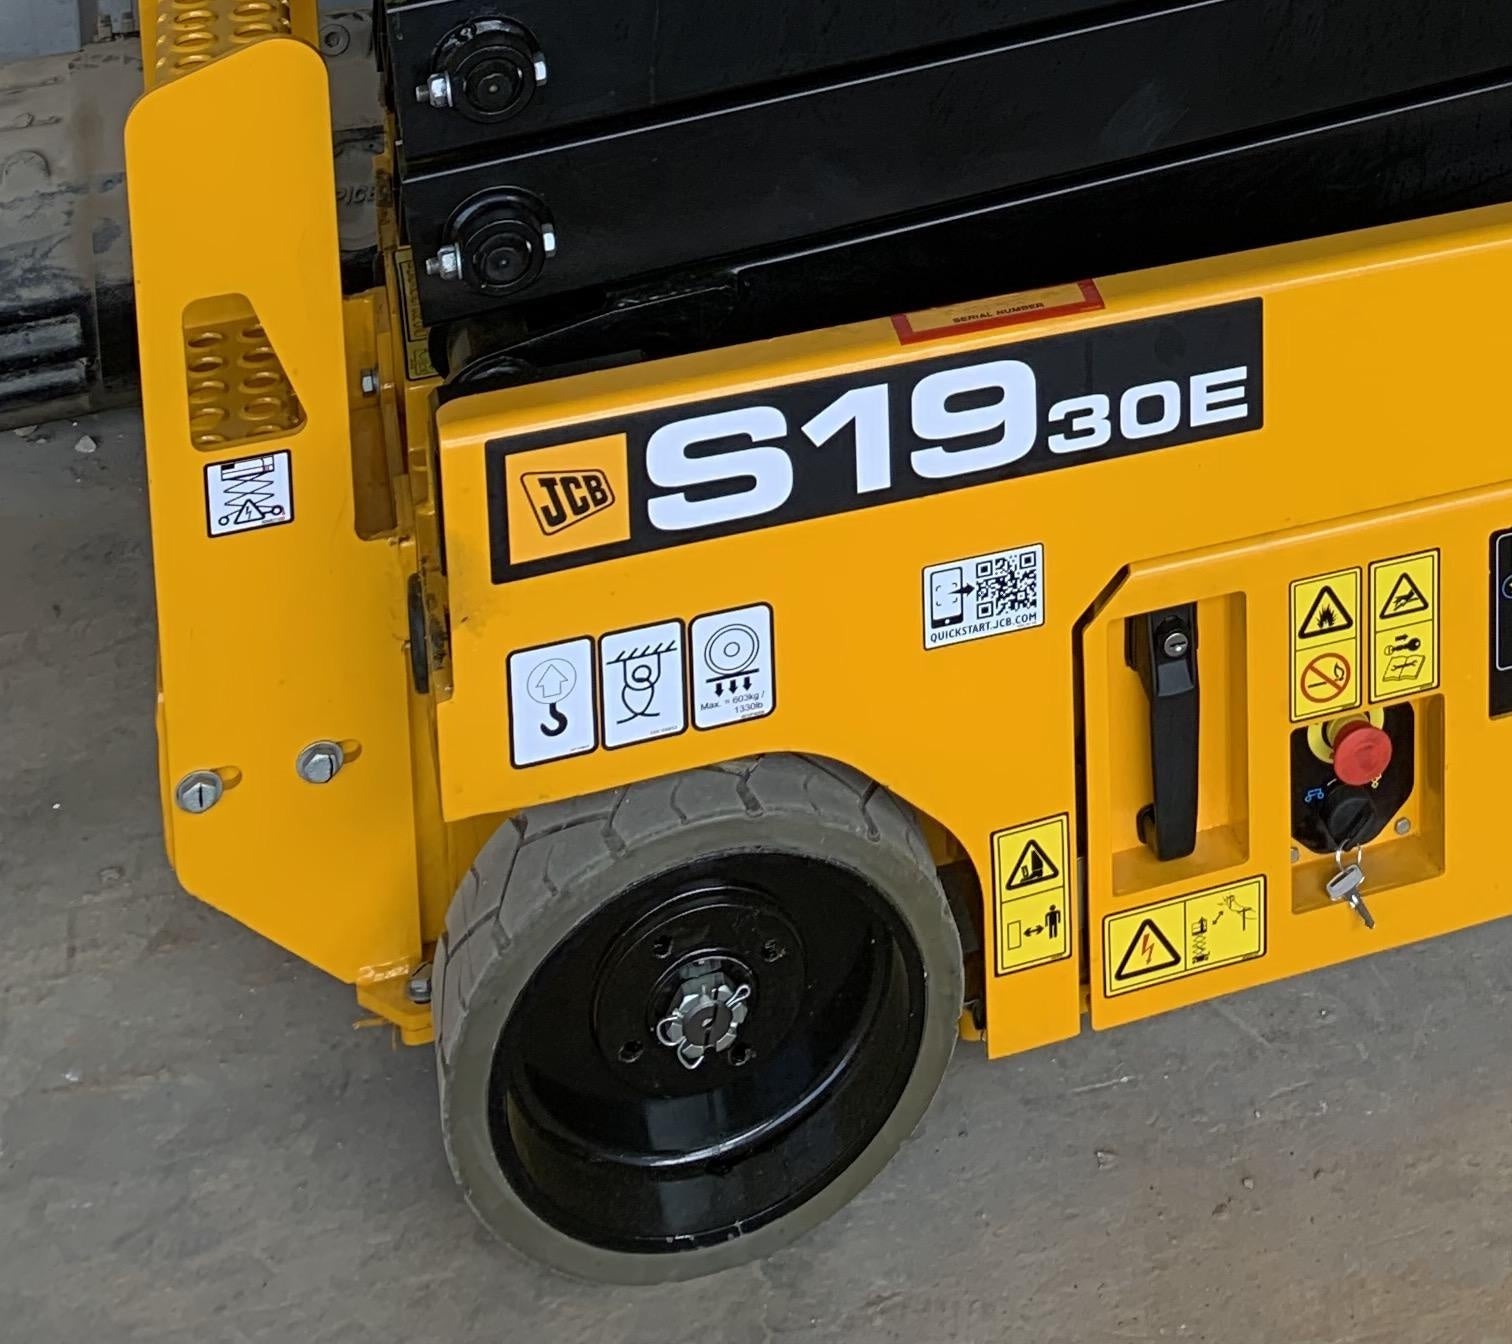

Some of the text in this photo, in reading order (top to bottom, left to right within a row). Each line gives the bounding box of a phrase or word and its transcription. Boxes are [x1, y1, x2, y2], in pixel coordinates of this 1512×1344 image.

[952, 302, 1044, 324] SERIAL NUMBER
[537, 472, 613, 531] JCB
[930, 612, 1037, 643] QUICKSTART.JCB.COM
[700, 701, 721, 712] Max.
